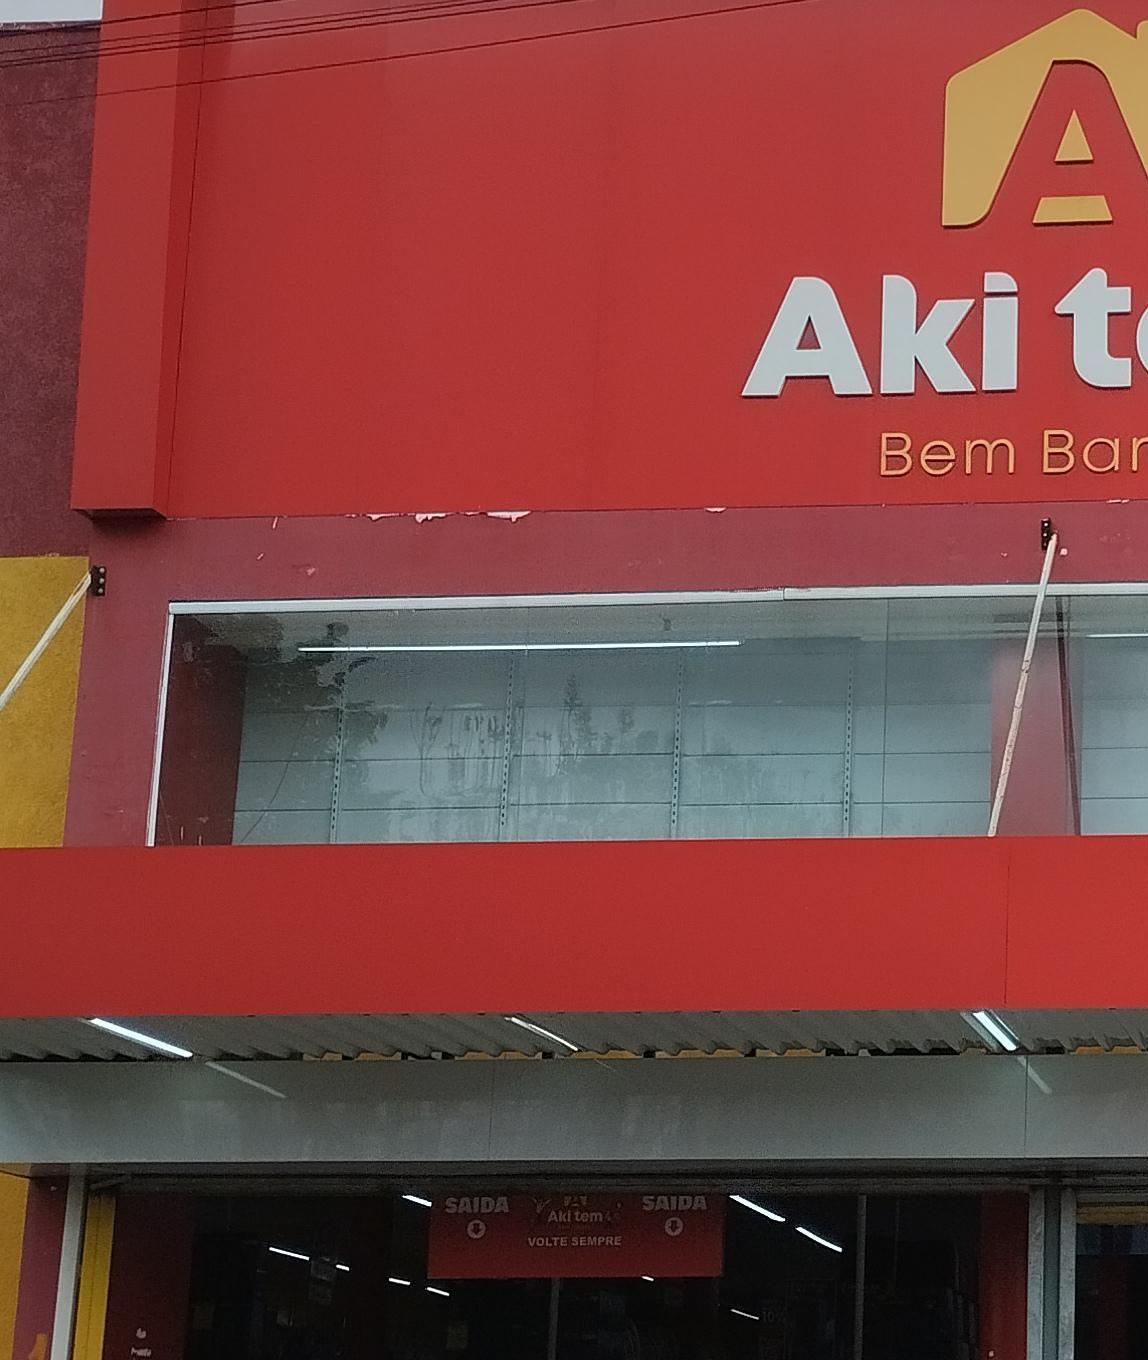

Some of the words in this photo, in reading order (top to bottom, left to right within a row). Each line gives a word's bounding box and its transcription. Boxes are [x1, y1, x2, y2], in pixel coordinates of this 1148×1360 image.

[741, 271, 1020, 398] Aki
[879, 431, 1016, 478] Bem
[547, 1210, 572, 1223] Aki
[574, 1209, 603, 1223] tem
[527, 1236, 568, 1247] VOLTE
[571, 1235, 623, 1247] SEMPRE
